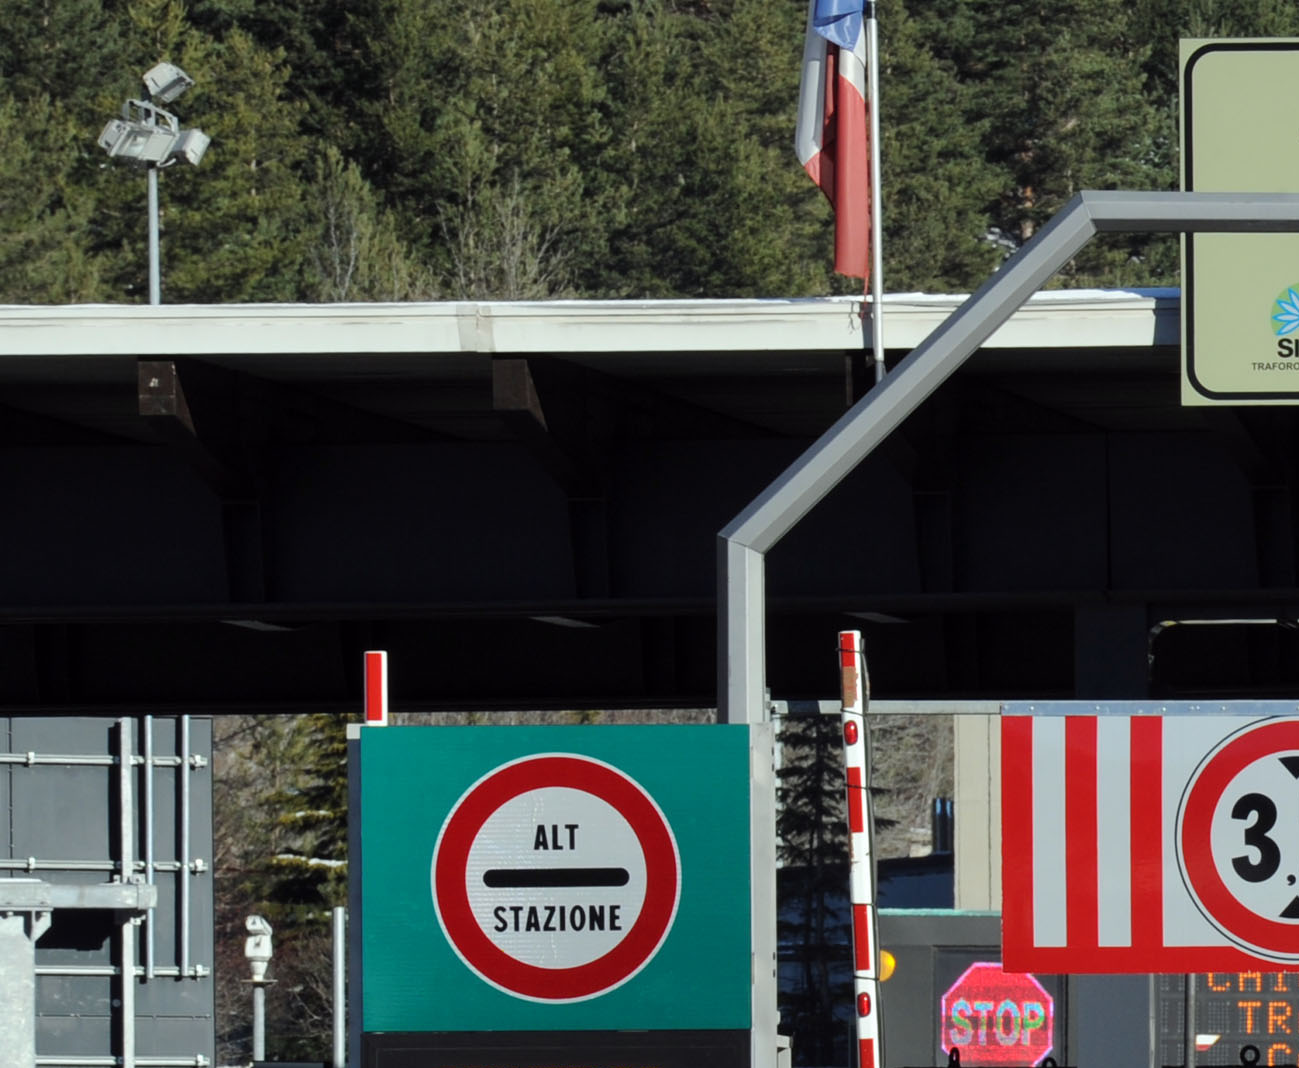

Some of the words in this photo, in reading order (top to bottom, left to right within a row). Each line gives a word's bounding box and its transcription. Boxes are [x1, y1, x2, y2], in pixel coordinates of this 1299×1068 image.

[533, 824, 579, 852] ALT
[493, 904, 623, 933] STAZIONE
[950, 998, 1045, 1046] STOP
